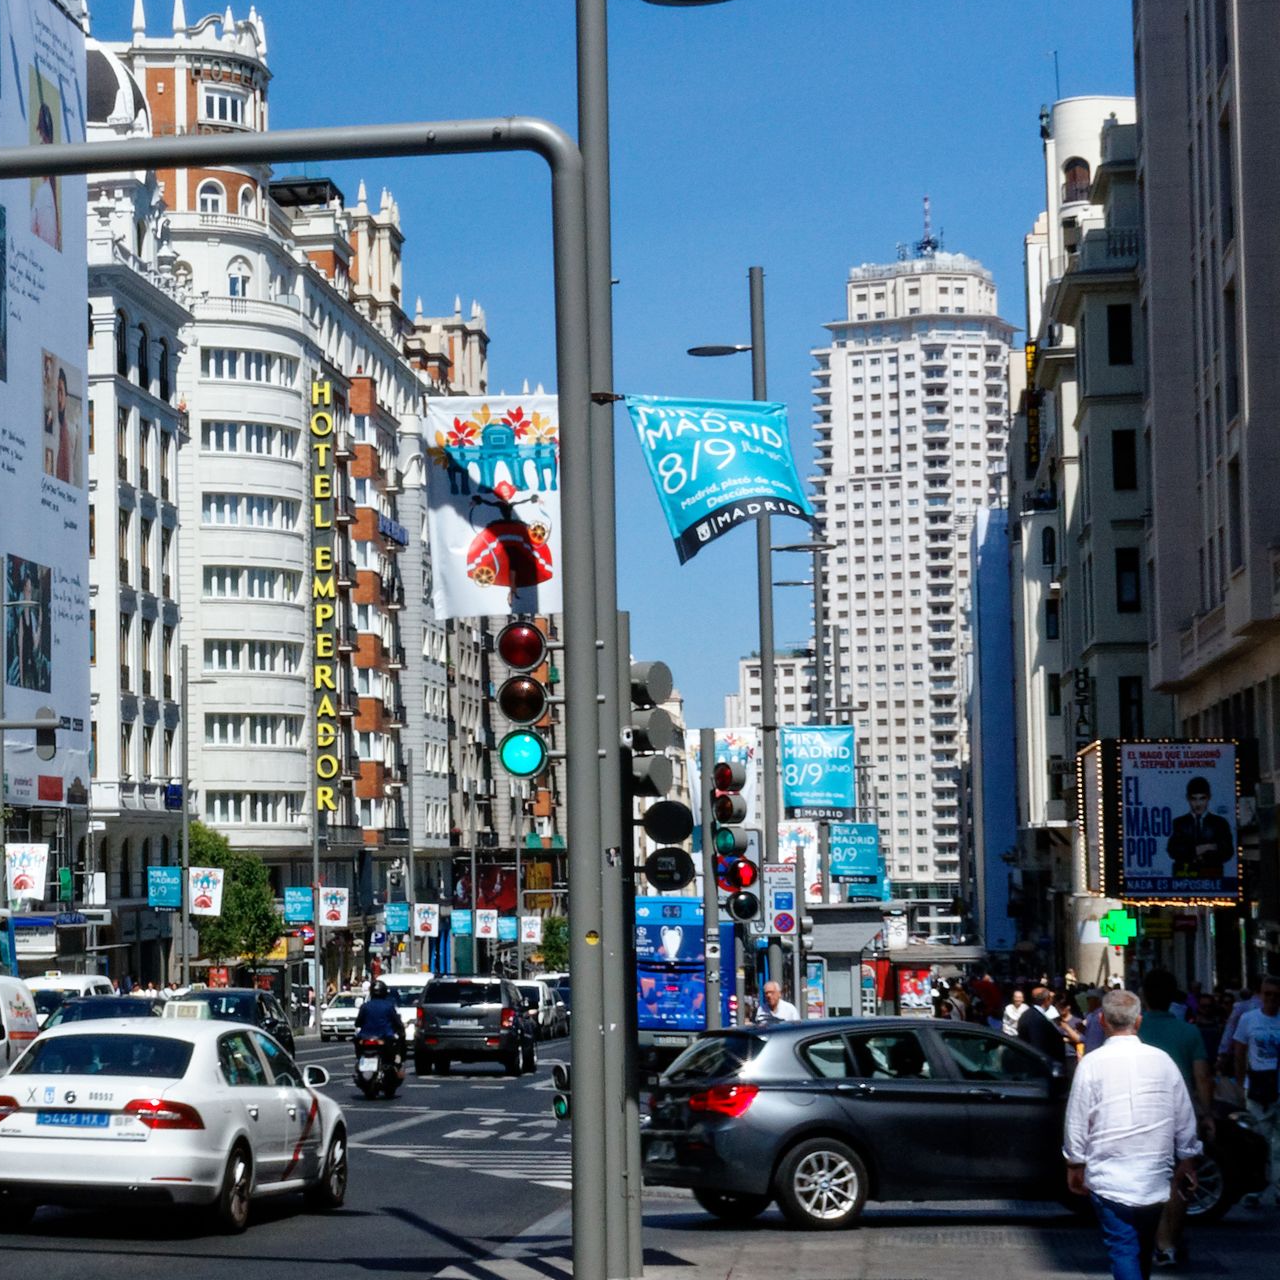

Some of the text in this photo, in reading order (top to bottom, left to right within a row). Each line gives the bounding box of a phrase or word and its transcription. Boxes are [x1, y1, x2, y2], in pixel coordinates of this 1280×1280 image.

[646, 416, 783, 450] MADRID
[310, 380, 333, 529] HOTEL
[658, 438, 736, 495] 8/9
[718, 501, 801, 528] MADRID
[312, 546, 339, 811] EMPERADOR
[784, 746, 851, 759] MADRID
[785, 733, 827, 745] MIRA
[785, 763, 823, 786] 8/9
[1124, 776, 1143, 806] EL
[1125, 807, 1172, 837] MAGO
[832, 836, 876, 845] MADRID
[832, 847, 858, 862] 8/9
[1126, 837, 1158, 868] POP
[150, 885, 168, 897] 8/9
